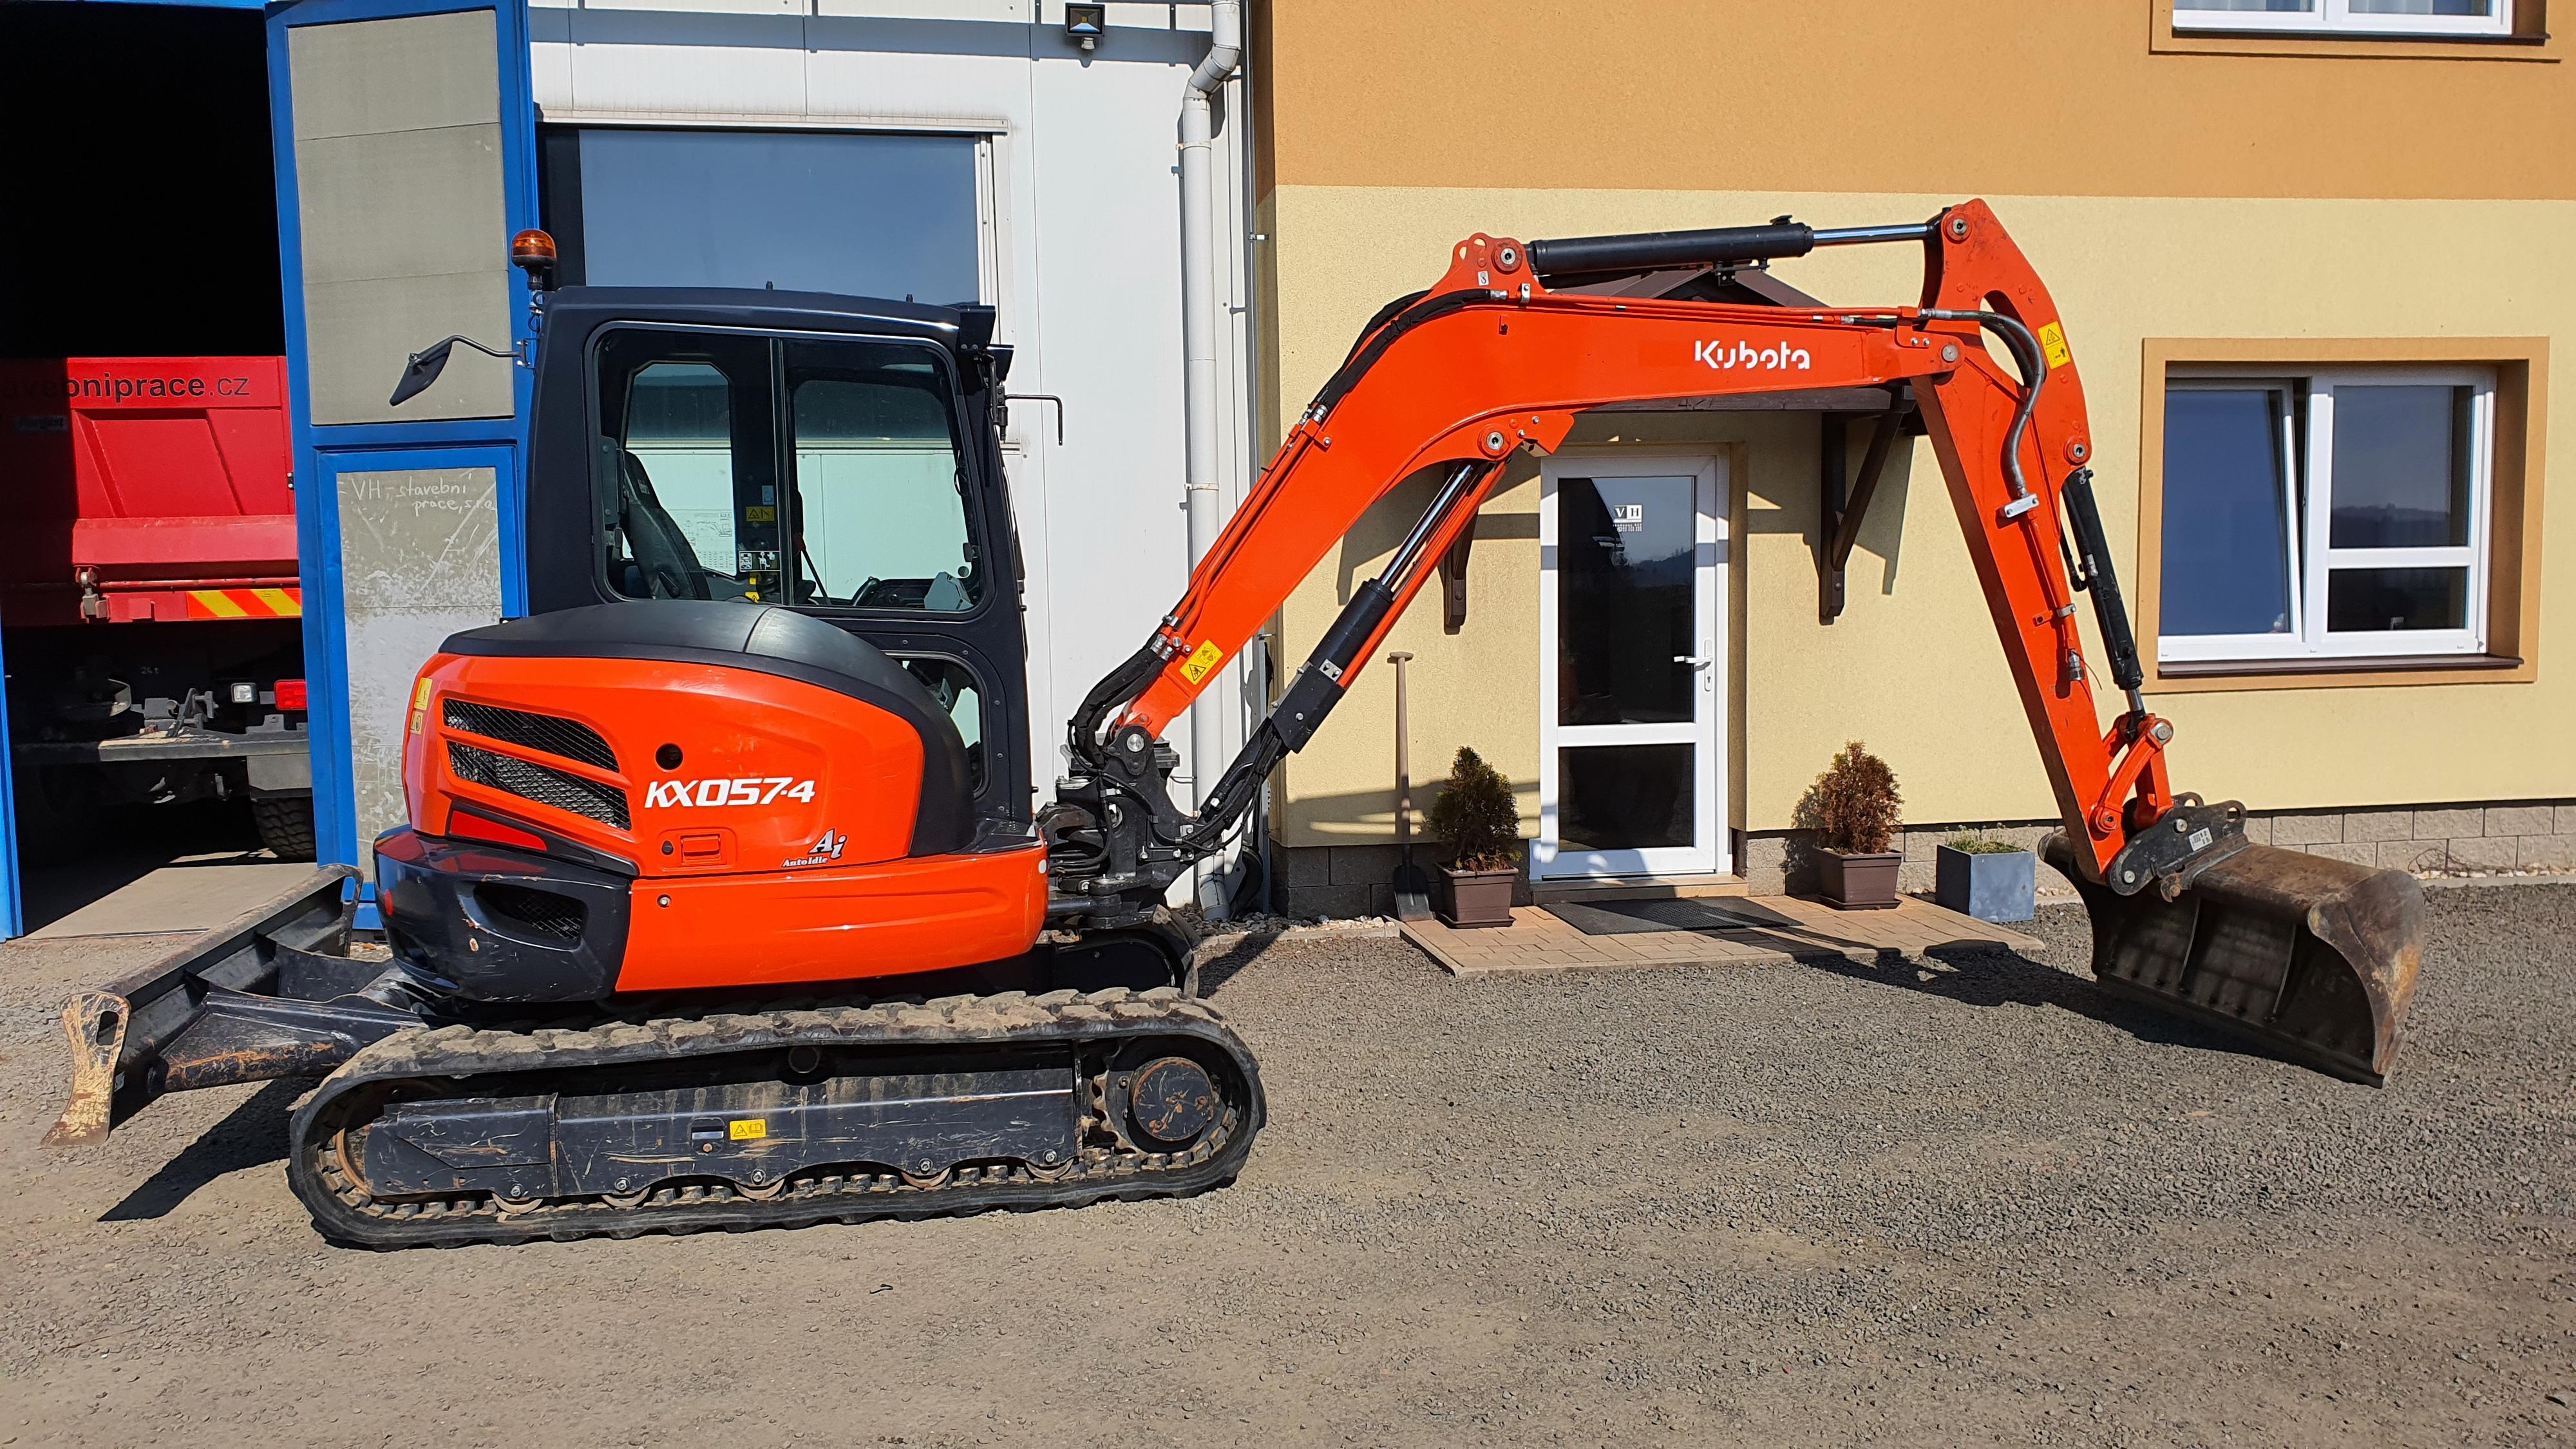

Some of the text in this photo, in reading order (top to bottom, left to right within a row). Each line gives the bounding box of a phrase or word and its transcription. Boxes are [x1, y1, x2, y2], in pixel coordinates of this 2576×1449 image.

[1694, 340, 1810, 370] Kubota
[351, 478, 381, 500] VH
[645, 777, 815, 808] KX057-4
[808, 829, 847, 858] Ai
[782, 856, 828, 867] AutoIdle
